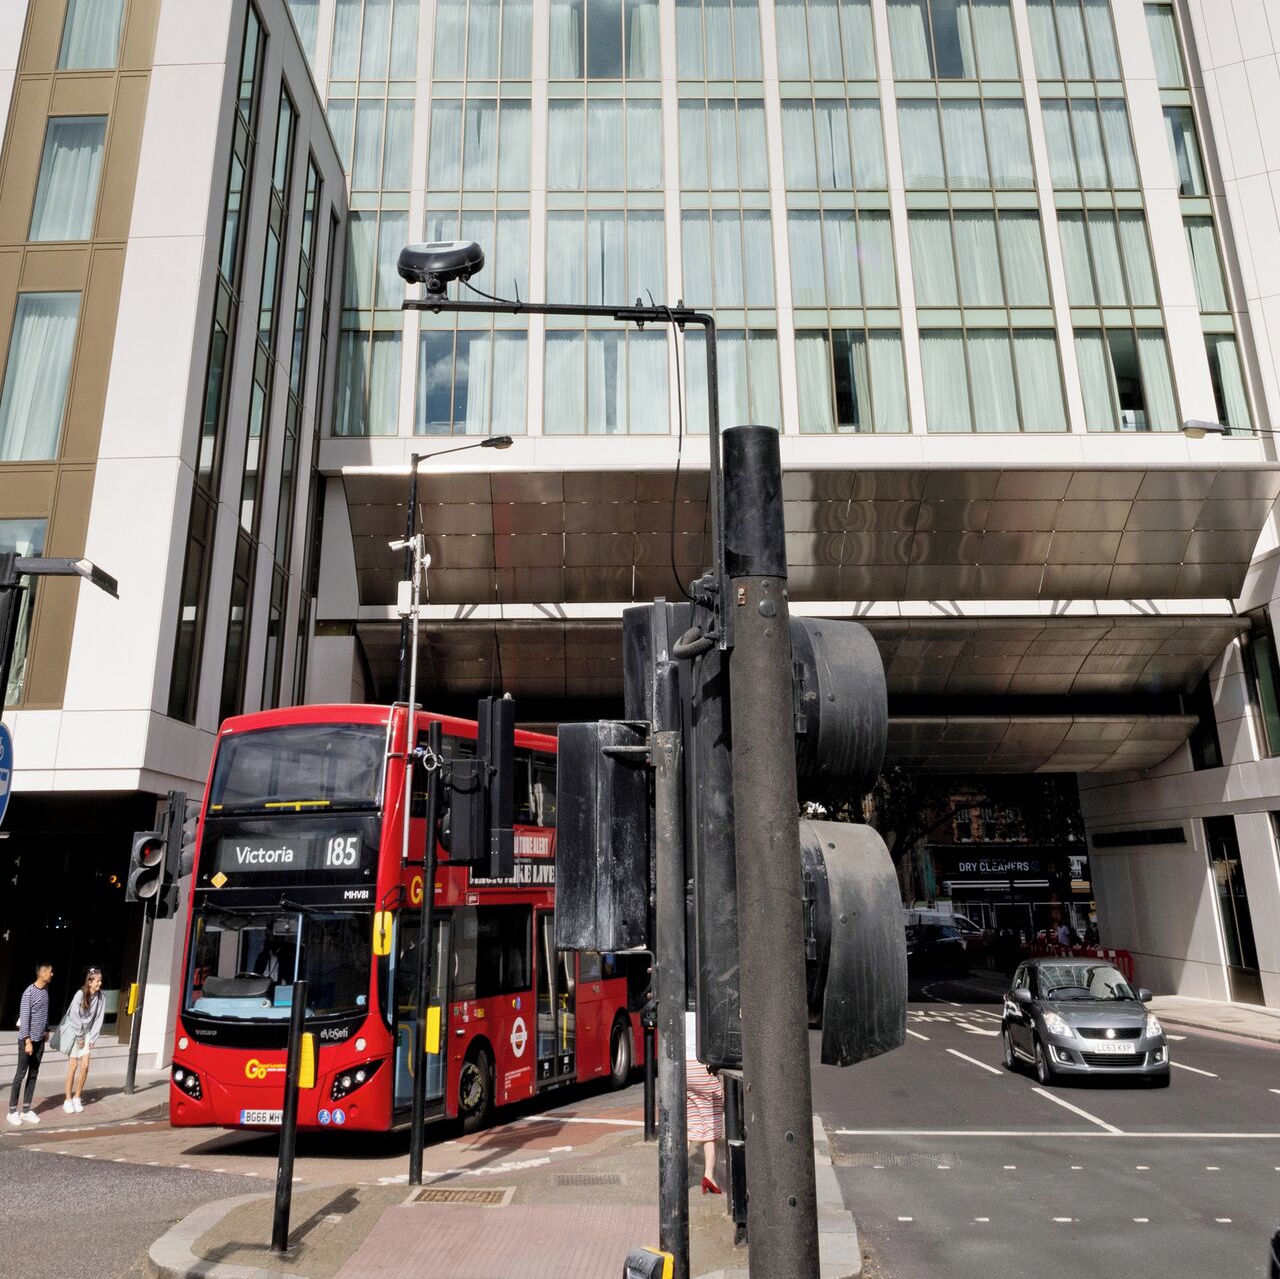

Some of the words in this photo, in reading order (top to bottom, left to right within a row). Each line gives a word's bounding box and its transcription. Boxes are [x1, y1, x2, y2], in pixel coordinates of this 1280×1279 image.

[236, 846, 294, 864] Victoria
[325, 837, 358, 866] 185
[533, 864, 555, 883] LIVE
[959, 862, 977, 872] DRY
[979, 861, 1030, 872] CLEANERS
[344, 890, 369, 899] MHV81
[1096, 1043, 1117, 1052] LC63
[245, 1058, 267, 1079] Go
[246, 1111, 267, 1122] BG66
[270, 1111, 283, 1122] MH
